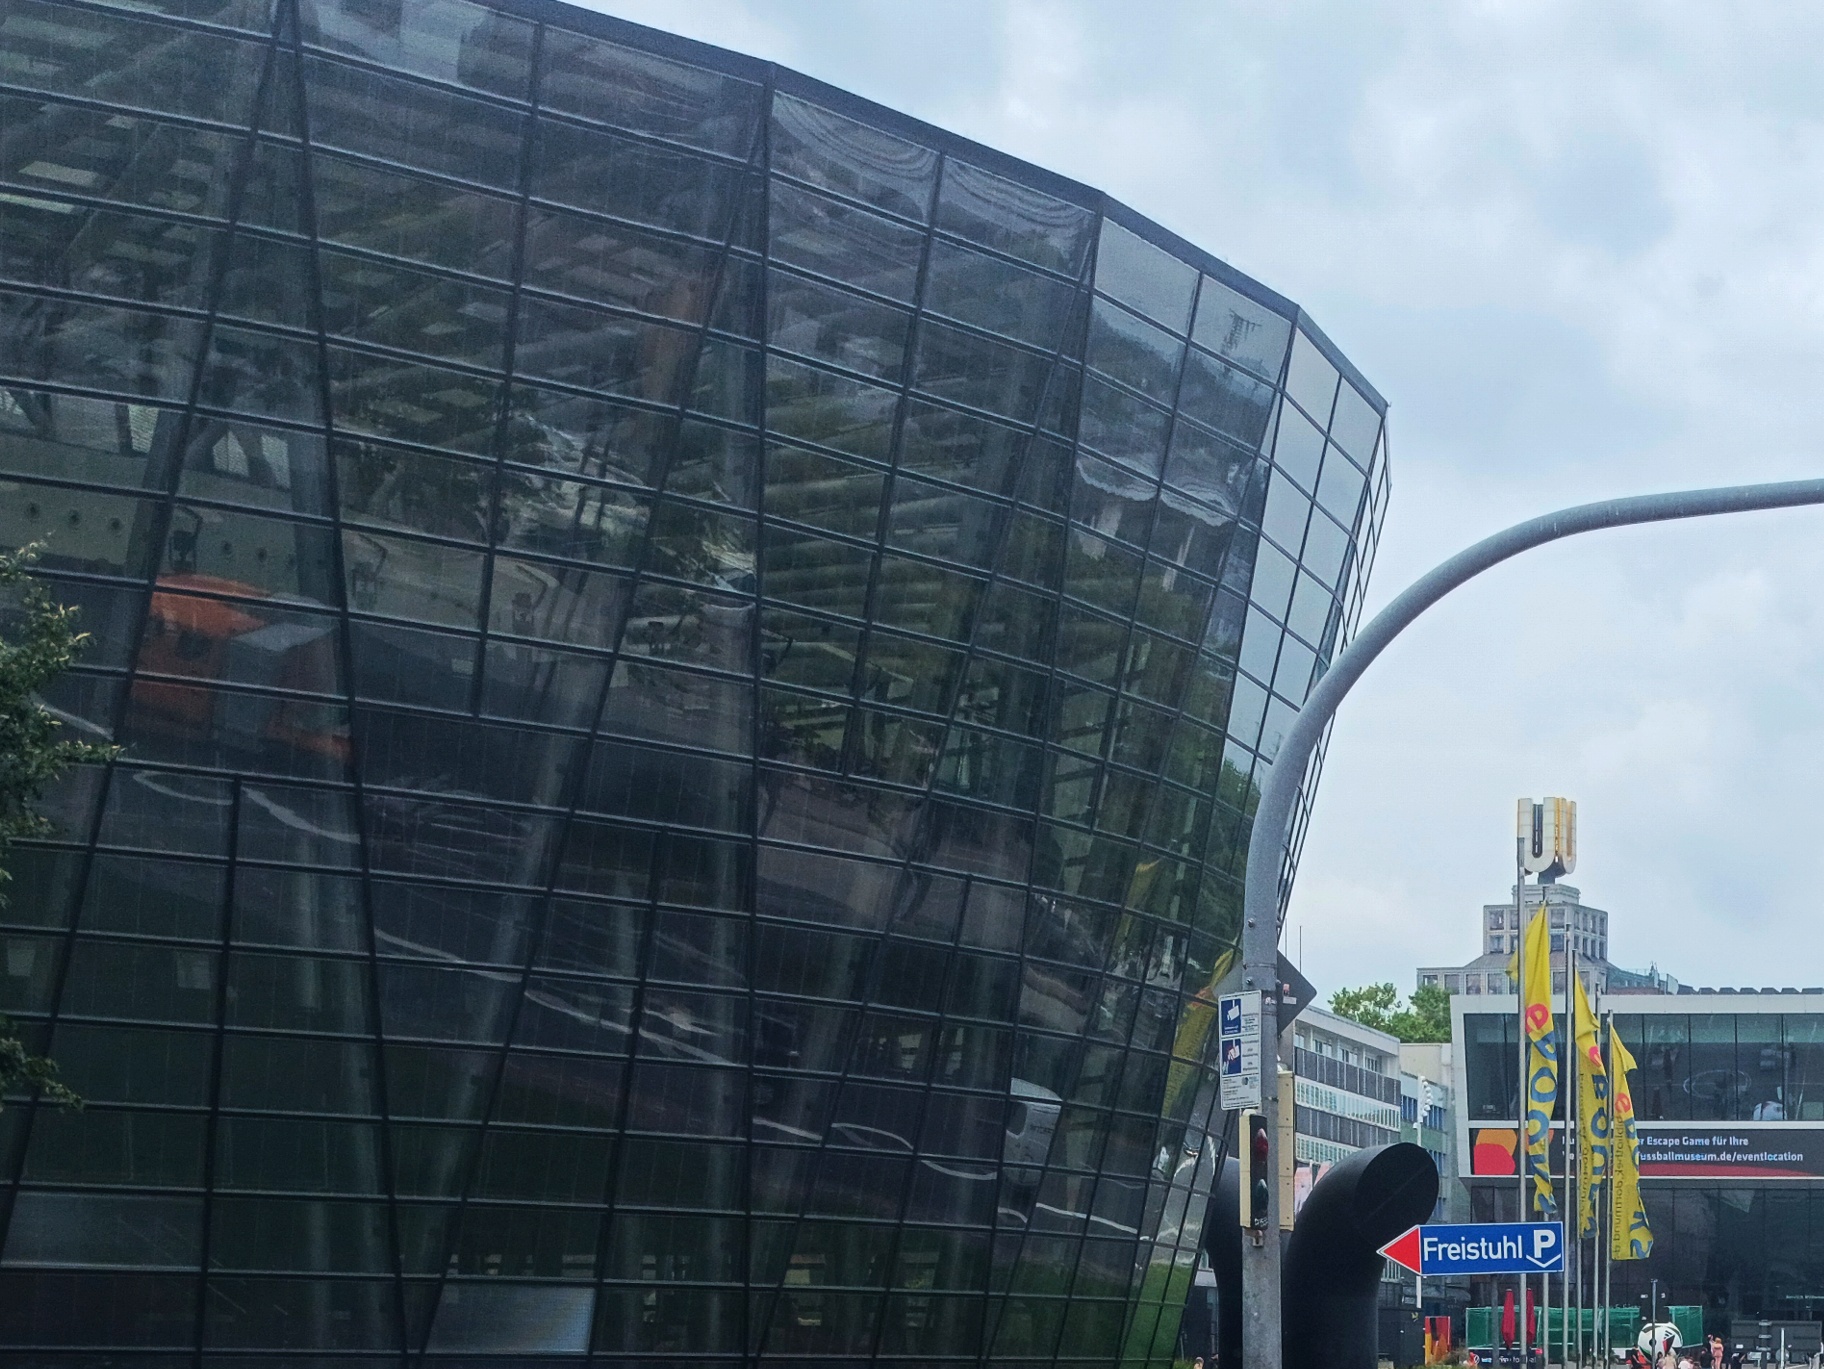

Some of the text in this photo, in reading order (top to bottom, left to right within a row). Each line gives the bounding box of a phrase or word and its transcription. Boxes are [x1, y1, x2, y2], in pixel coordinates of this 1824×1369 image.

[1647, 1137, 1680, 1148] Escape
[1682, 1137, 1710, 1146] Game
[1712, 1136, 1728, 1146] für
[1730, 1137, 1749, 1146] Ihre
[1423, 1229, 1556, 1262] Freistuhl P
